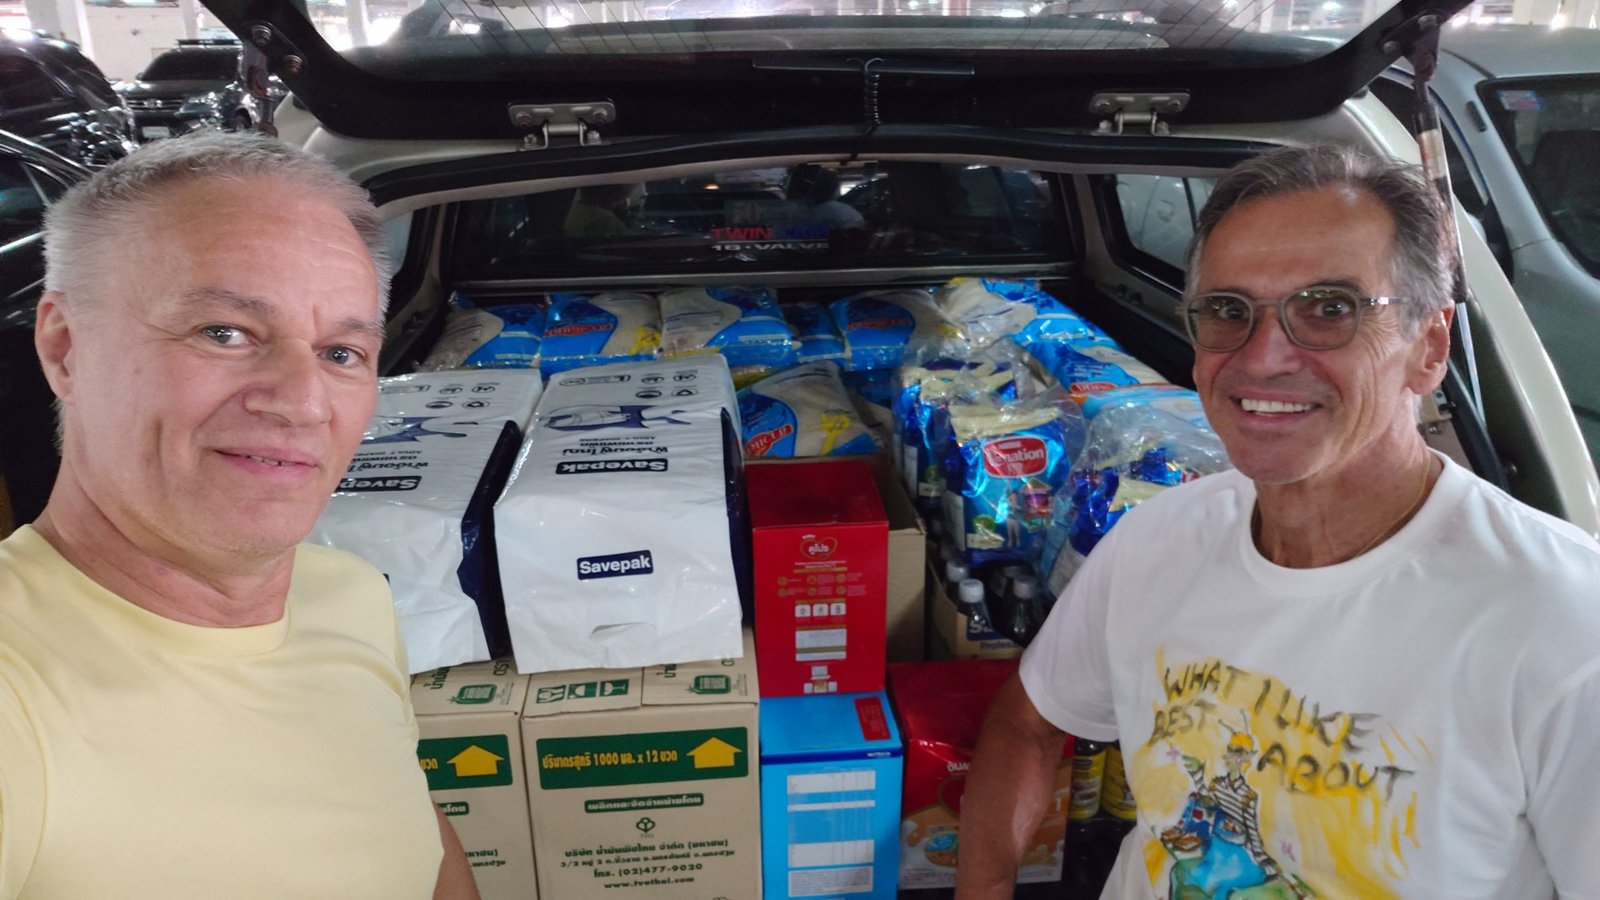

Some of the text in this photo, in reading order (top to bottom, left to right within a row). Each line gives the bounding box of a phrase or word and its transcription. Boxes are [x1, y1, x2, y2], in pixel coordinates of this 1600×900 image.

[710, 227, 773, 240] TWIN
[561, 461, 665, 472] Savepak
[341, 480, 416, 490] Savep
[580, 555, 651, 574] Savepak
[1163, 660, 1382, 752] WHAT I LIKE
[1152, 700, 1218, 740] BEST
[593, 751, 619, 766] 1000
[637, 754, 644, 764] x
[646, 750, 660, 763] 12
[660, 749, 678, 763] ขวด
[1257, 742, 1416, 803] ABOUT
[659, 840, 685, 851] จำกัด
[687, 838, 729, 850] (มหาชน)
[618, 862, 703, 877] (02)477-9020
[603, 876, 695, 889] www.tvothai.com
